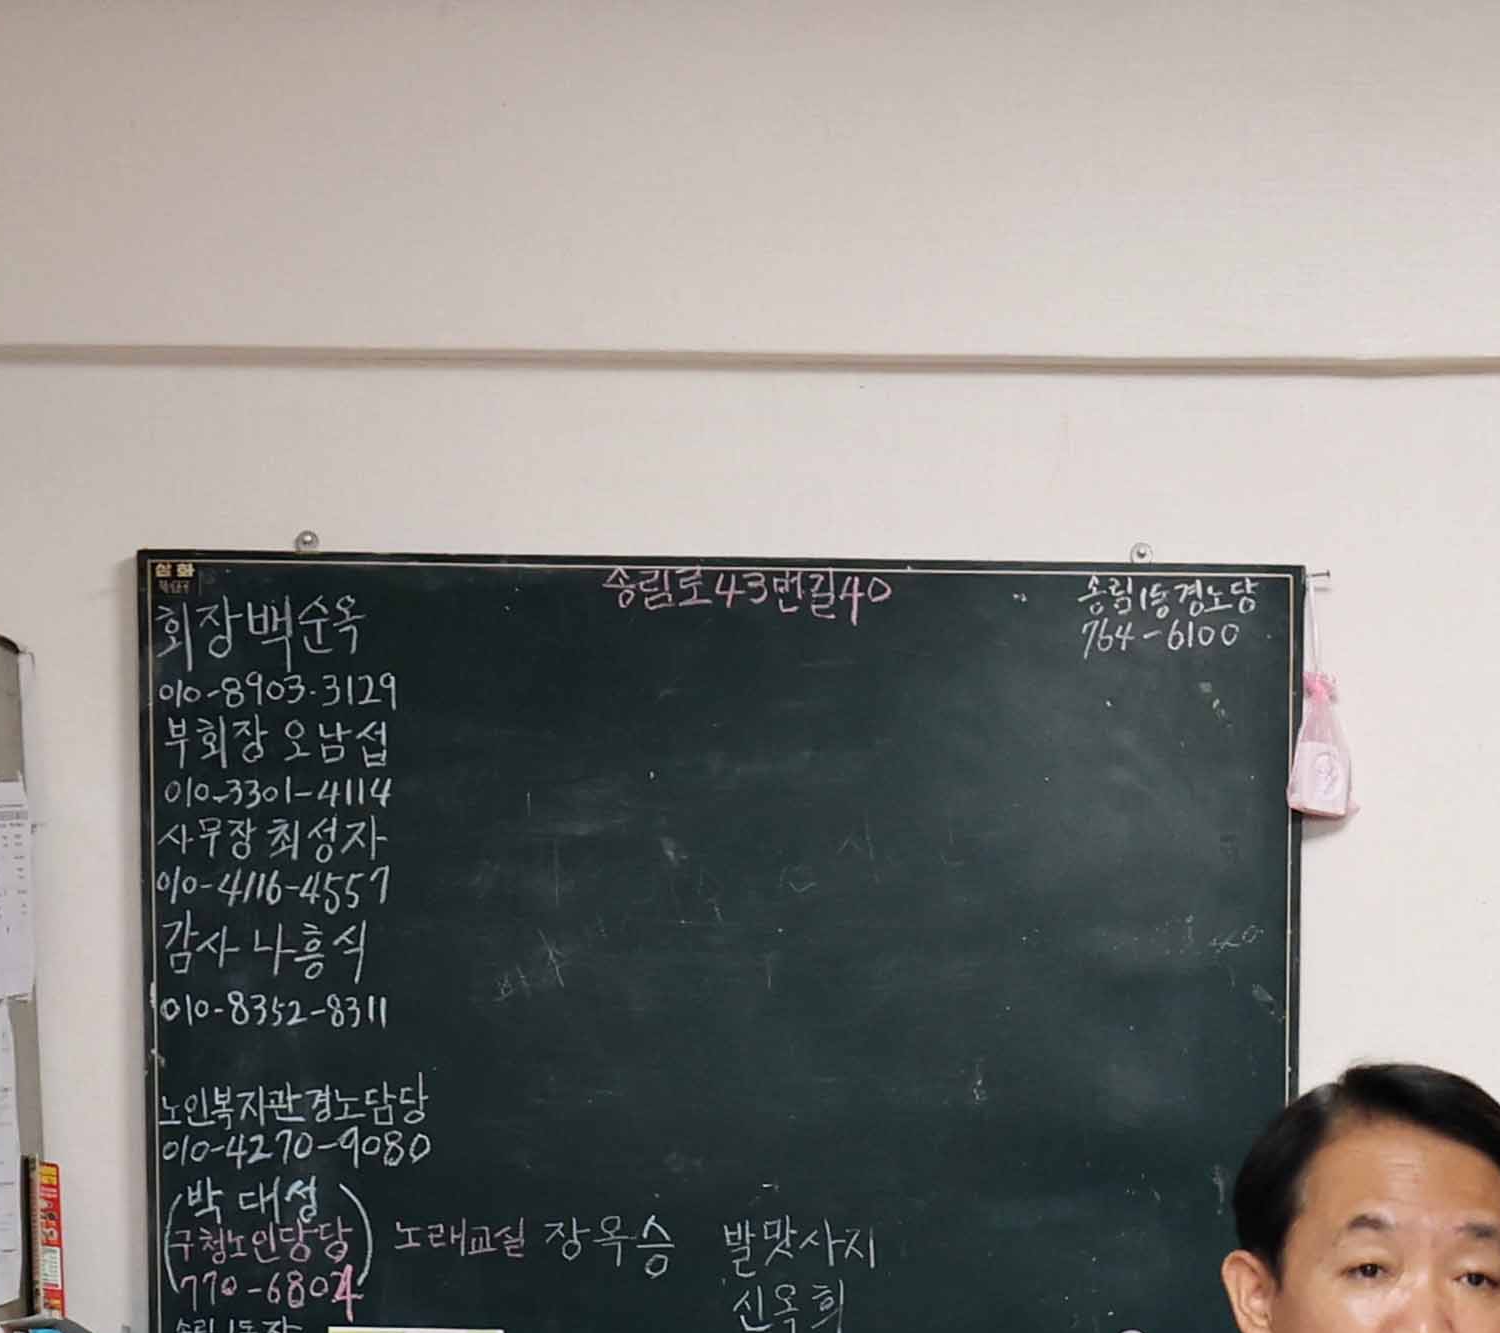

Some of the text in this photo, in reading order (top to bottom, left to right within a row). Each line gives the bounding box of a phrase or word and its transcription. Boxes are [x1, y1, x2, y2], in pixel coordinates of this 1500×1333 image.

[602, 567, 713, 610] 송림로
[1081, 617, 1240, 660] 764-6100
[165, 714, 386, 768] 부회장 오남섭
[165, 776, 391, 808] 010-3301-4114
[158, 816, 387, 863] 사무장 최성자
[163, 910, 239, 973] 감사
[161, 991, 386, 1027] 010-8352-8311
[163, 1126, 430, 1169] 010-4270-9080
[395, 1218, 524, 1257] 노래교실
